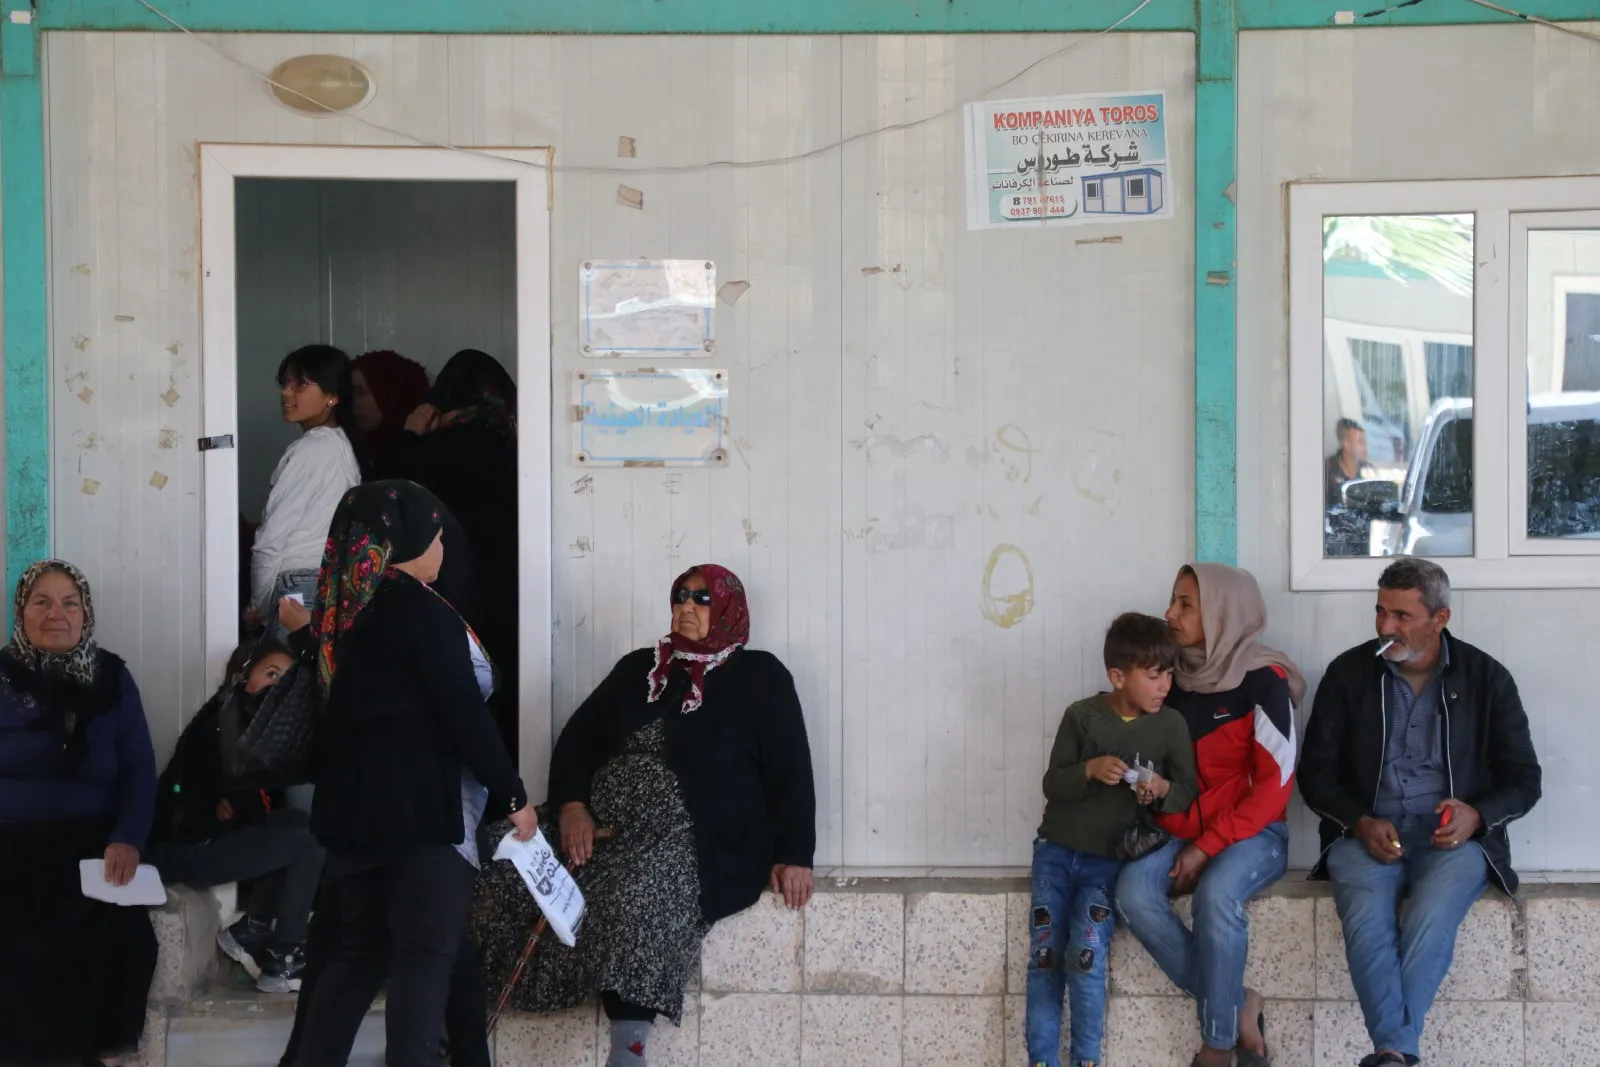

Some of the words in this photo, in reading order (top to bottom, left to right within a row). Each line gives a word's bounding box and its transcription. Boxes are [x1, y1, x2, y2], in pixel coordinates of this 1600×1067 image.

[993, 108, 1096, 130] KOMPANIYA
[1099, 103, 1158, 124] TOROS
[1012, 135, 1028, 145] BO
[1087, 128, 1148, 142] KEREVANA
[1082, 141, 1139, 168] شركة
[1010, 208, 1031, 216] 0937
[1049, 206, 1065, 214] 444
